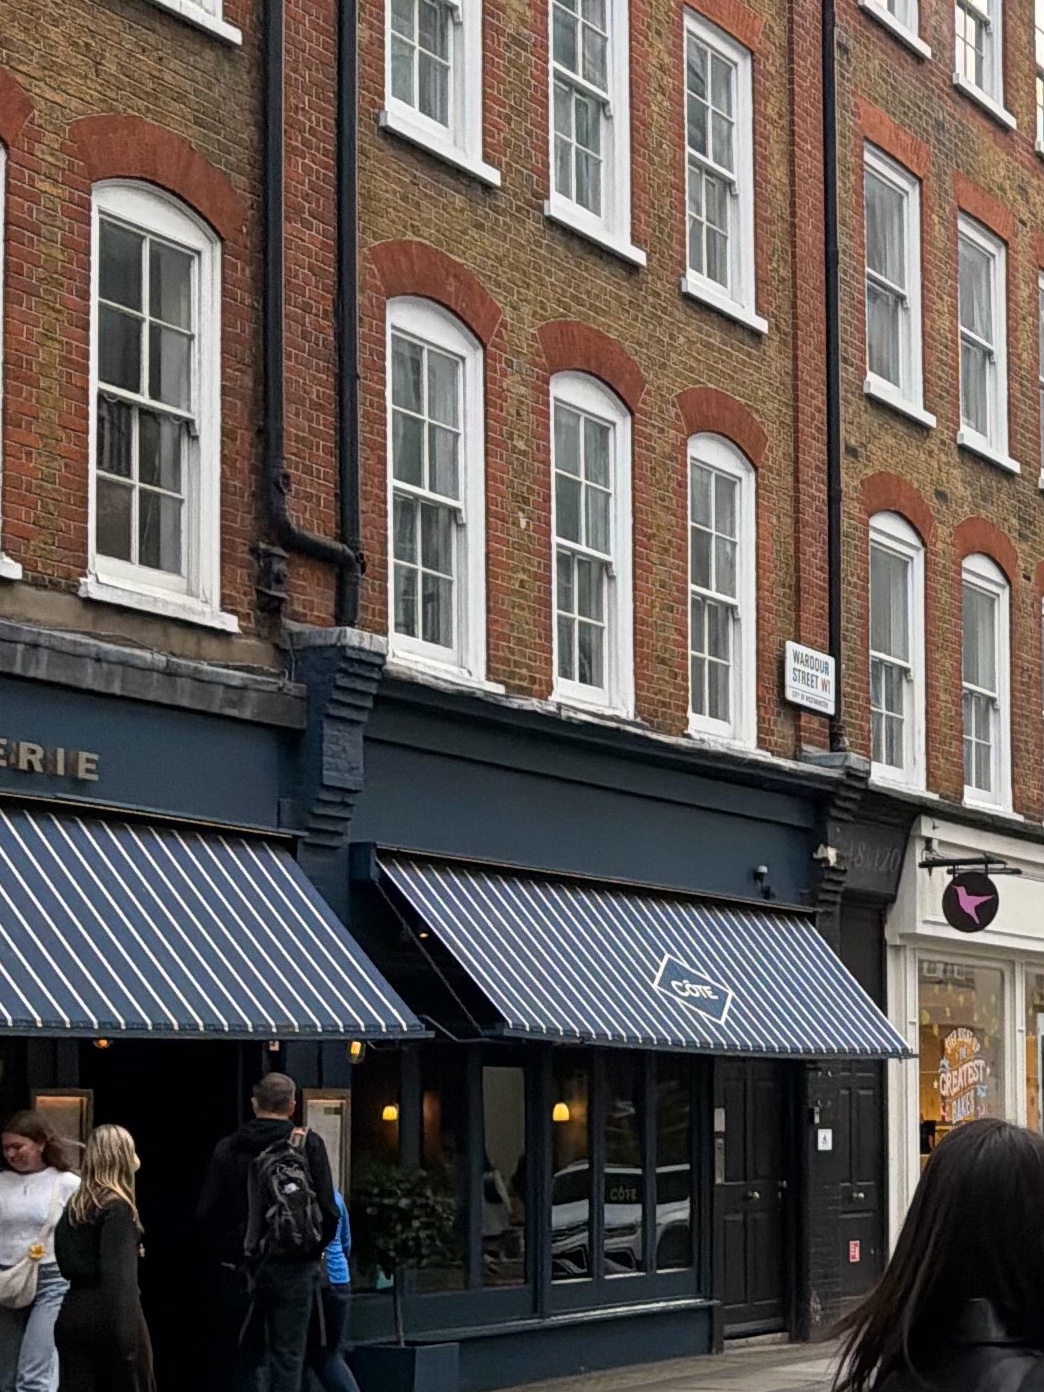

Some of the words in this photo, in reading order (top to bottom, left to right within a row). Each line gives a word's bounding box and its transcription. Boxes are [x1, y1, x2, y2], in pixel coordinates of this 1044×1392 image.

[792, 648, 830, 676] WARDOUR
[792, 667, 819, 690] STREET
[821, 678, 831, 694] W1
[940, 1059, 986, 1097] GREATEST
